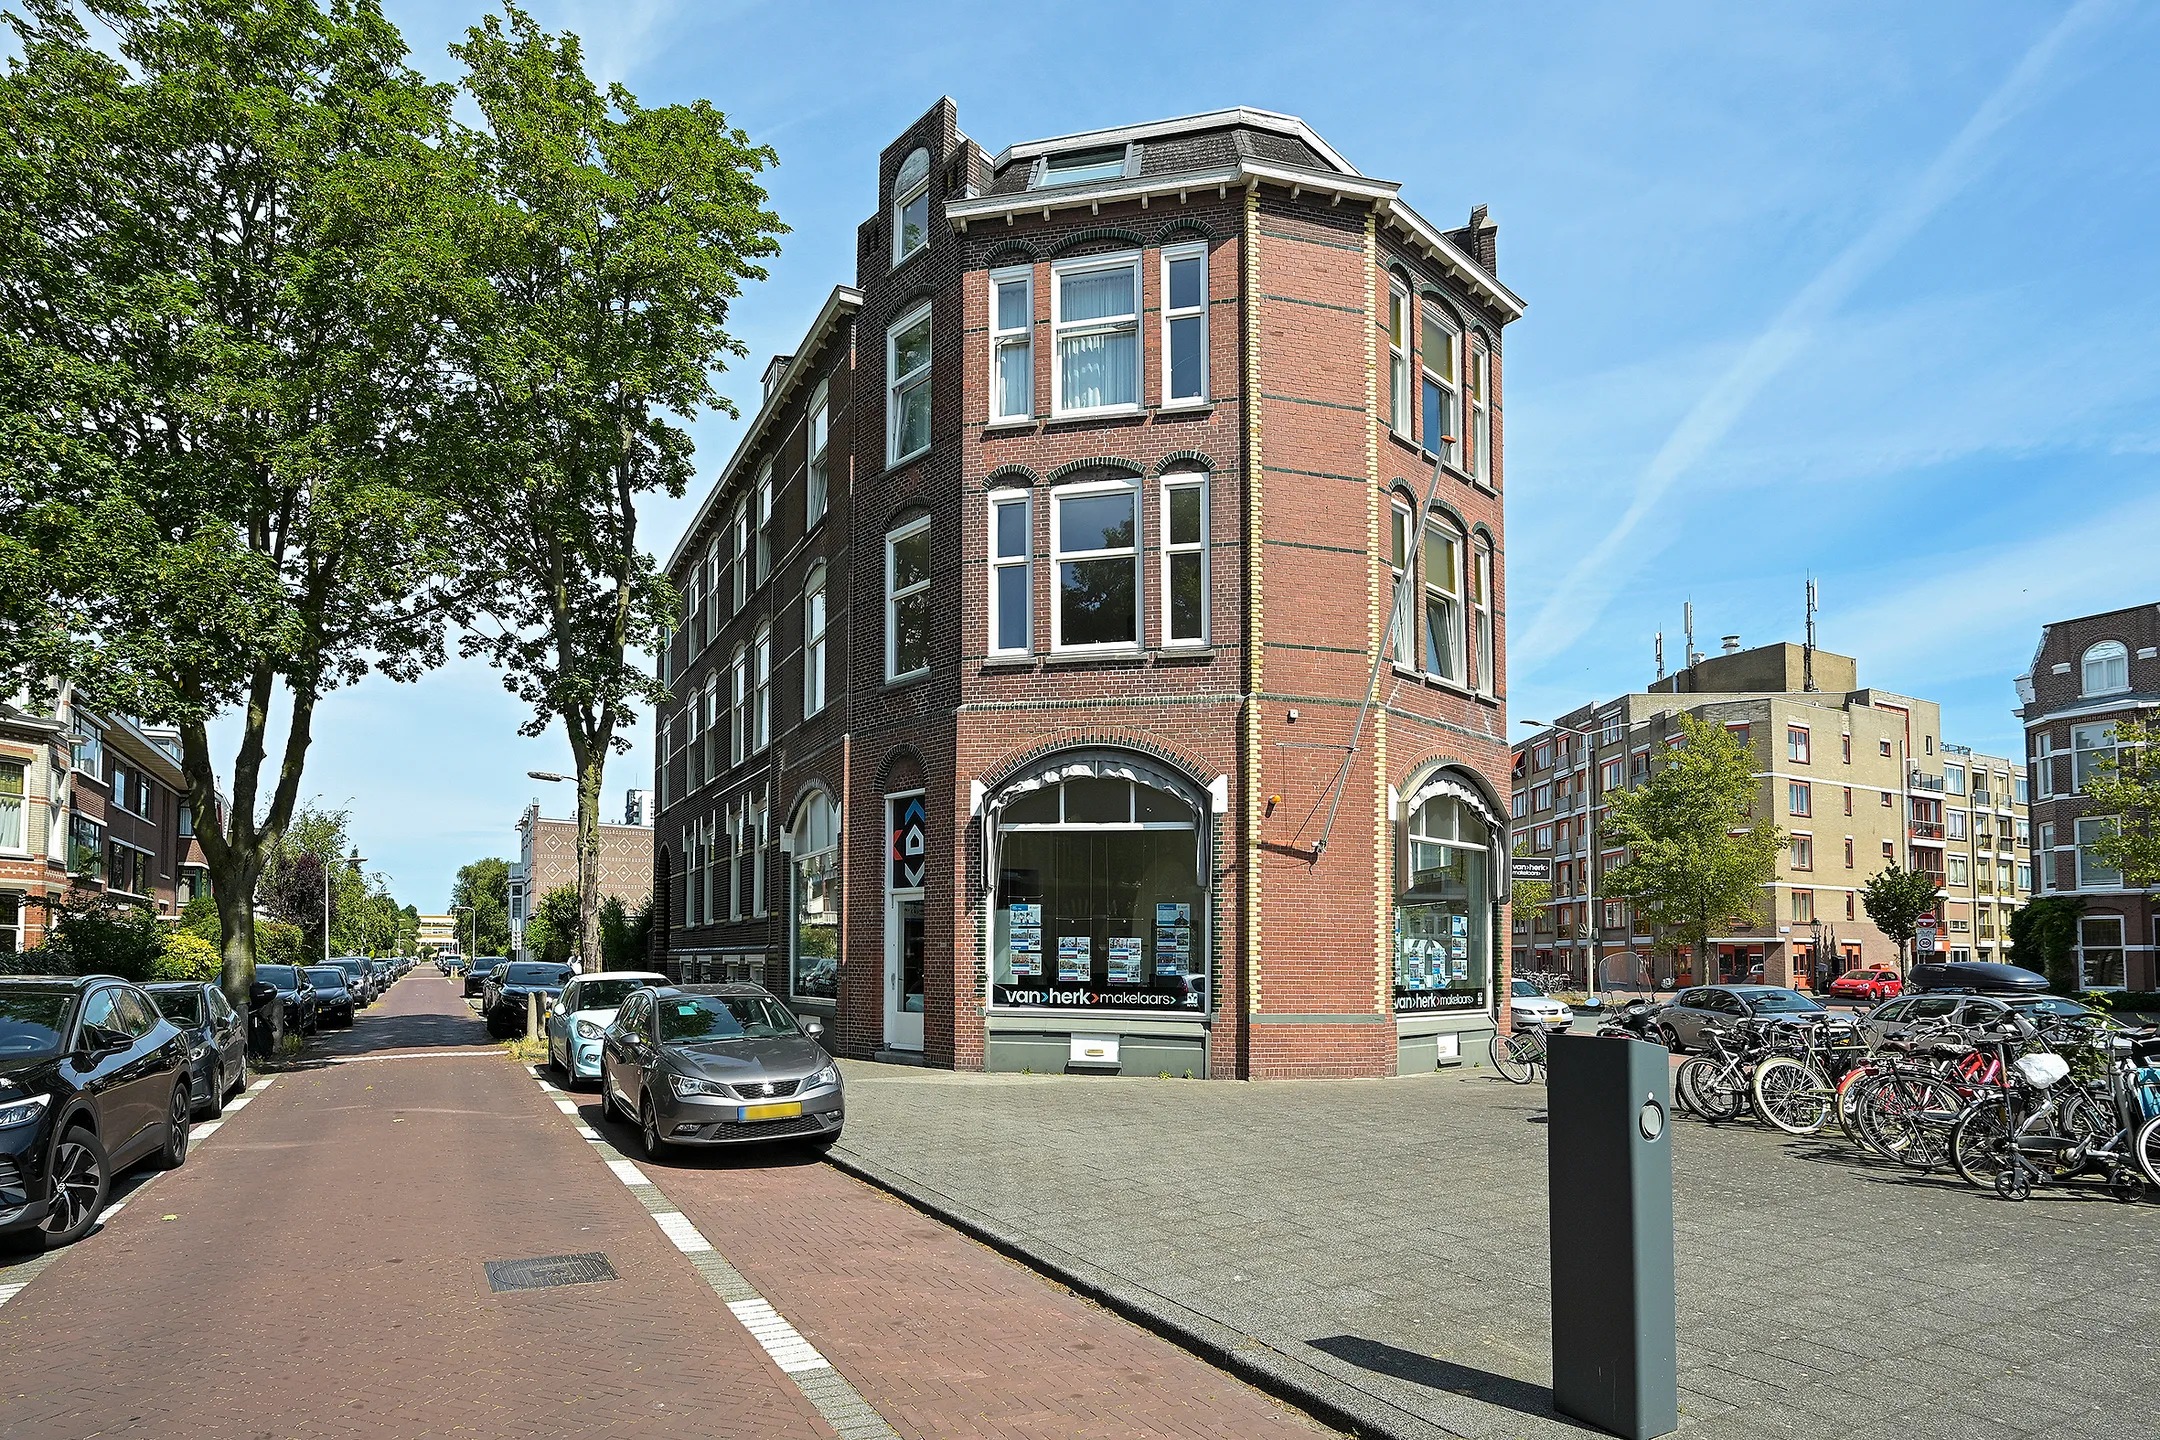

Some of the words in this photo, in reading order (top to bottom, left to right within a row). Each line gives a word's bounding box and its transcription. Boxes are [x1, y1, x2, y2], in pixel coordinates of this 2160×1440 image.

[1005, 990, 1041, 1003] van
[1049, 988, 1091, 1004] herk
[1100, 992, 1170, 1004] makelaars
[1395, 996, 1412, 1009] van
[1416, 992, 1437, 1008] herk
[1440, 994, 1471, 1006] makelaars
